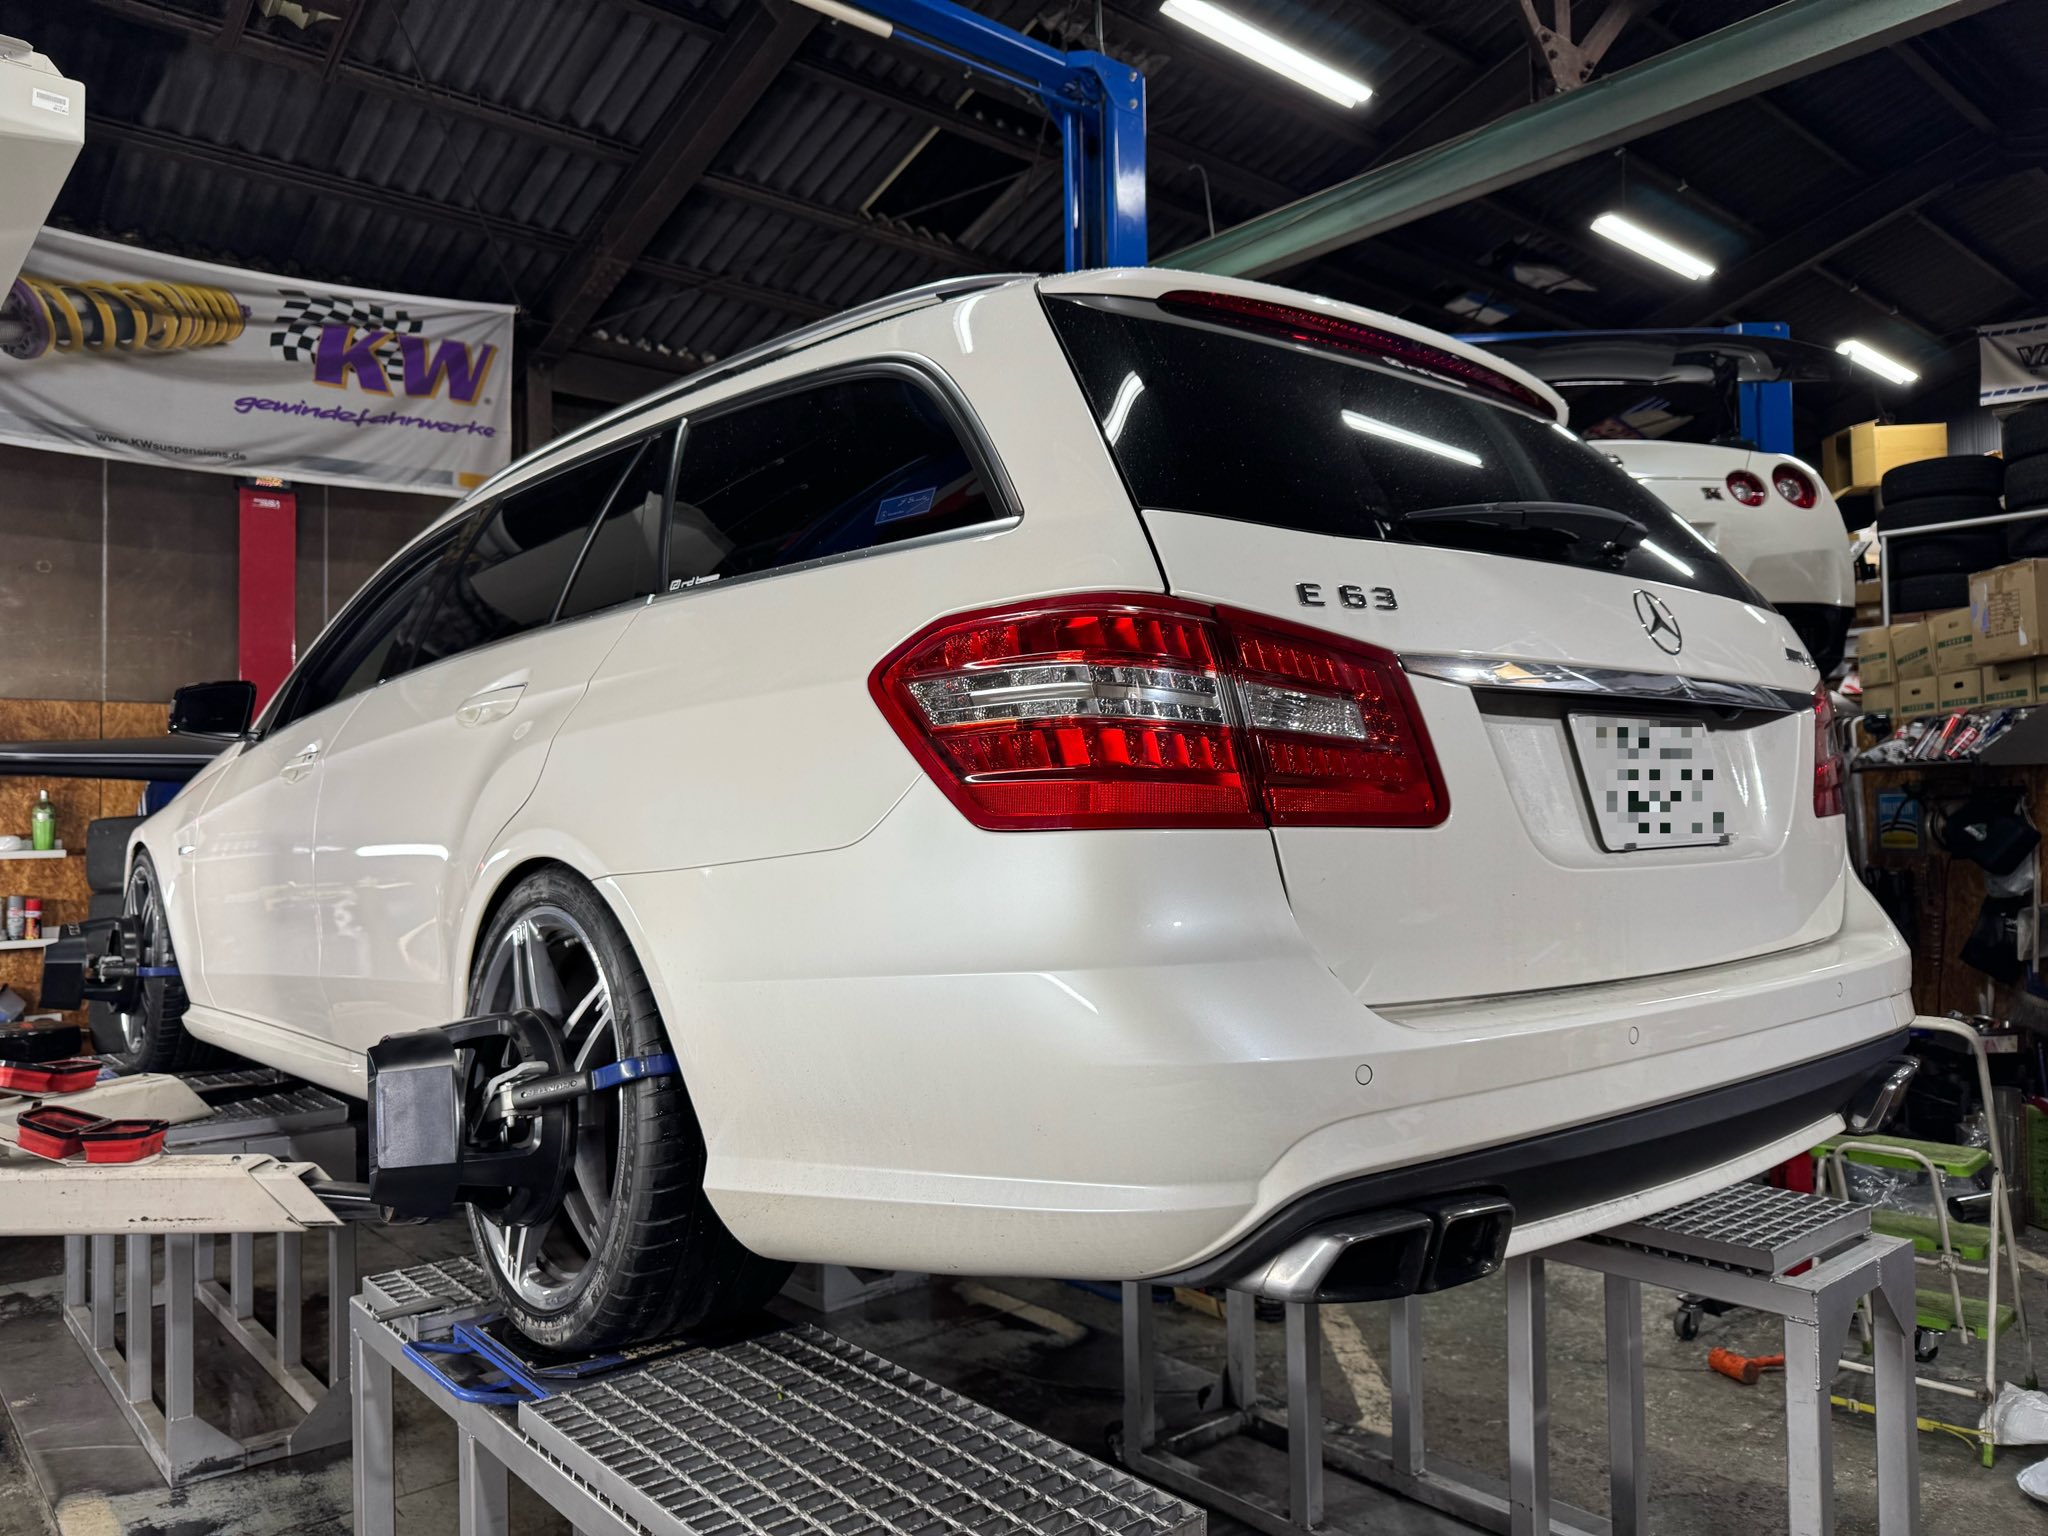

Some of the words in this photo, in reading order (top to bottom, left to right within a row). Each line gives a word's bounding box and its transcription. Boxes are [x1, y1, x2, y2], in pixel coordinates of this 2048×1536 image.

[313, 324, 498, 406] KW
[234, 396, 496, 438] gewindefahrwerke
[96, 433, 246, 461] www.KWsuspensions.de
[1295, 582, 1326, 607] E
[1337, 584, 1399, 611] 63
